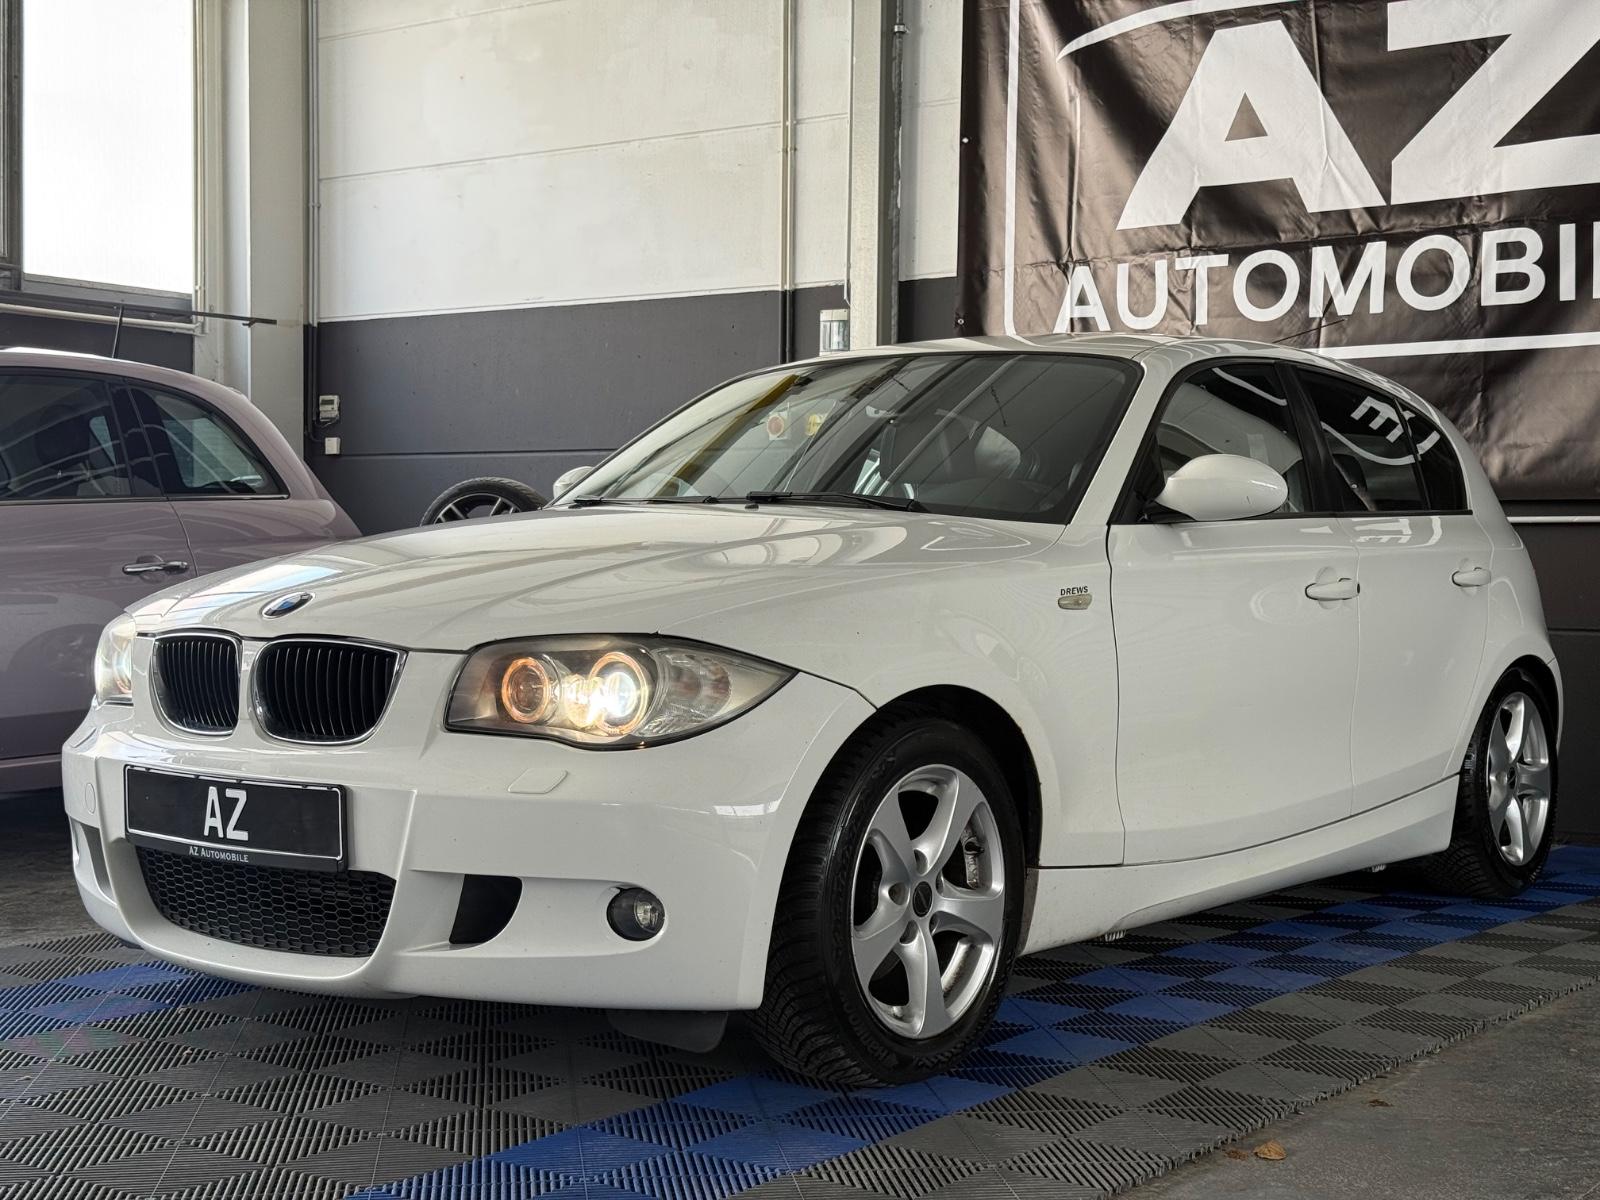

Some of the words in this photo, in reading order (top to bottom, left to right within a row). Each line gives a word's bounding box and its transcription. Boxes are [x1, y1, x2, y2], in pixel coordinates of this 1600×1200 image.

[1117, 0, 1600, 231] AZ
[1053, 220, 1600, 334] AUTOMOBI
[1060, 585, 1089, 596] DREWS
[203, 786, 248, 841] AZ
[189, 846, 199, 856] AZ
[201, 849, 249, 862] AUTOMOBILE
